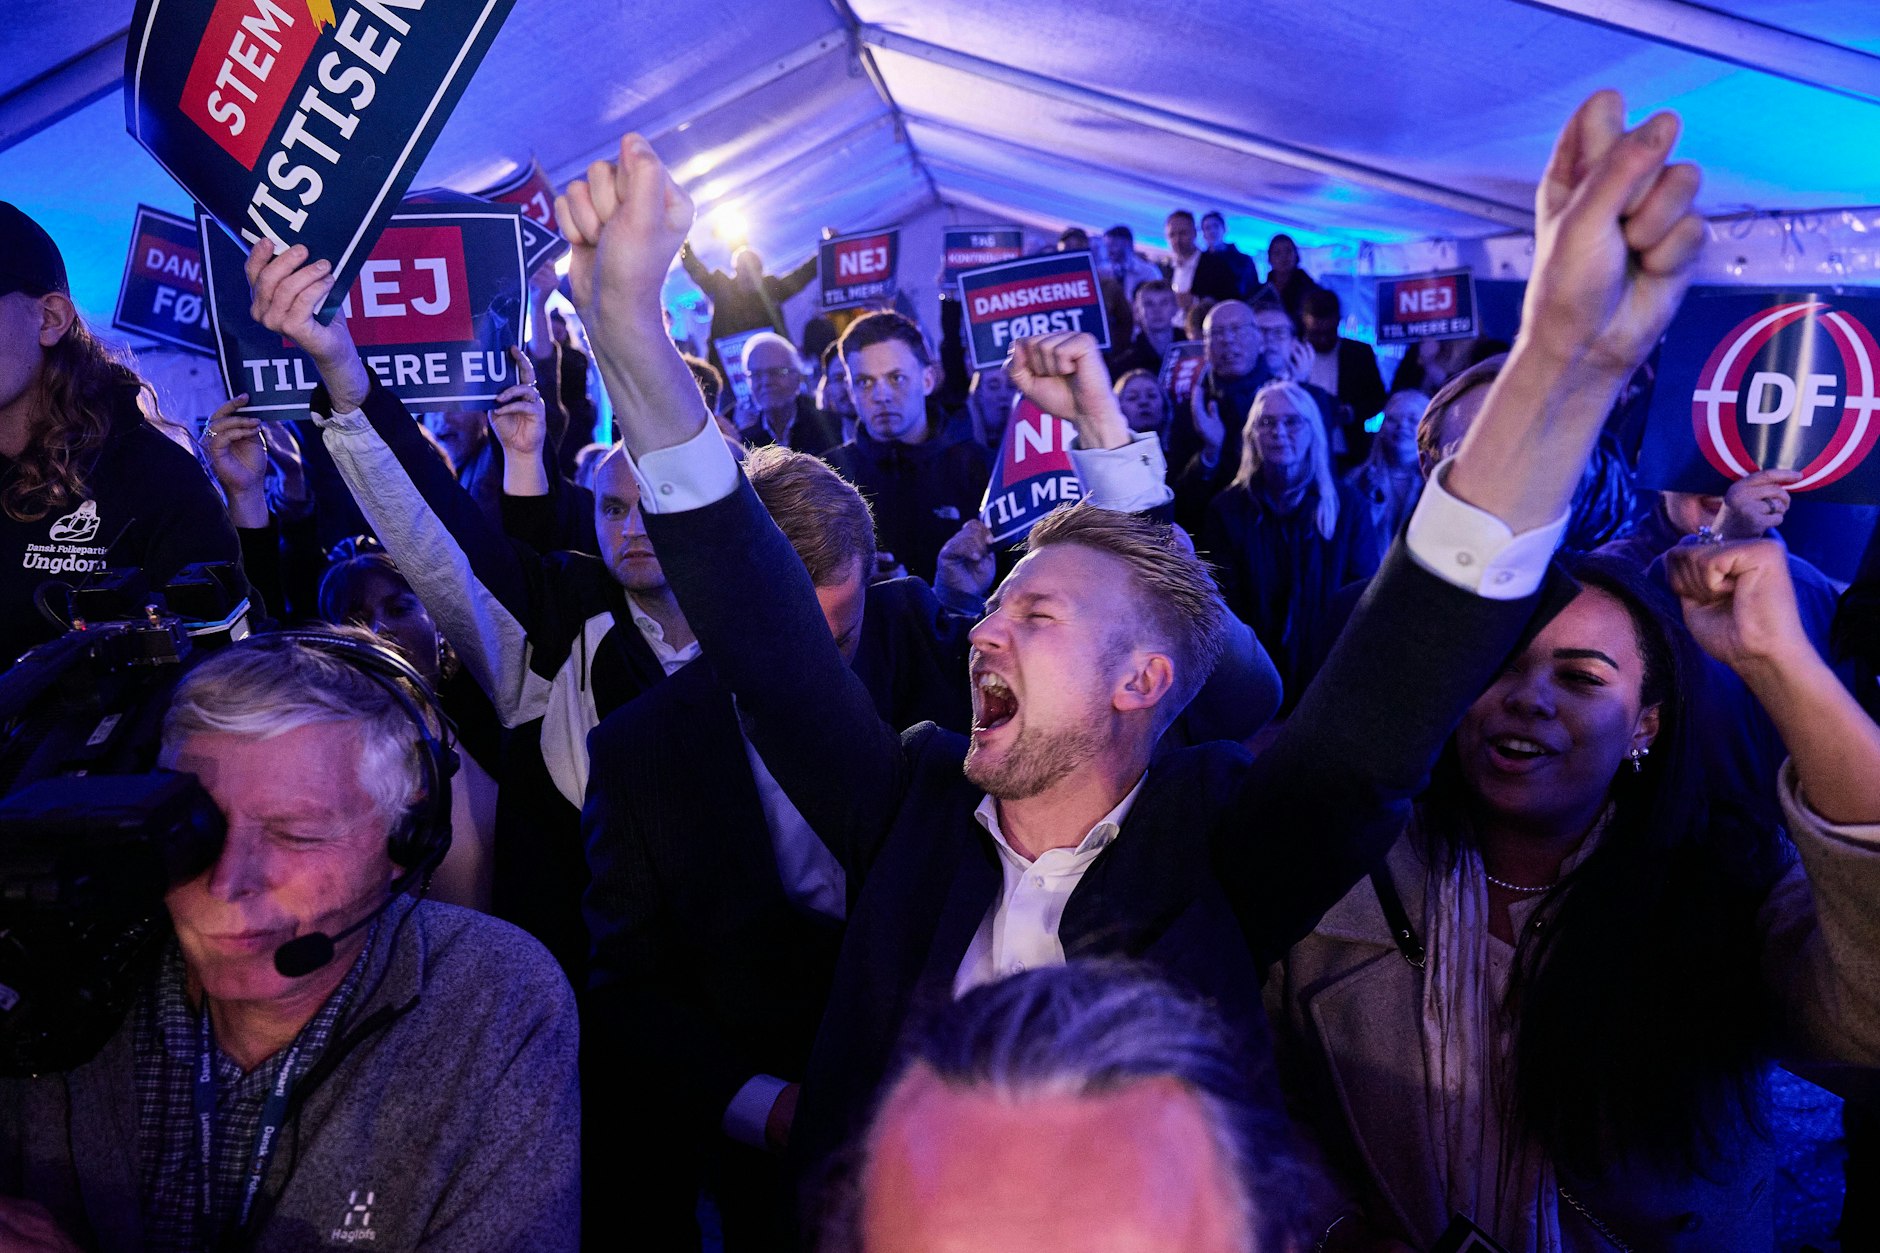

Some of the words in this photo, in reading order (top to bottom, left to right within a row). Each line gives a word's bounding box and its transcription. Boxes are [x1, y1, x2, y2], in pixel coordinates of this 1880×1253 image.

[207, 0, 295, 136] STEM
[146, 248, 203, 283] DAN
[840, 247, 887, 277] NEJ
[341, 257, 451, 319] EJ
[973, 280, 1091, 316] DANSKERNE
[1399, 286, 1452, 314] NEJ
[152, 285, 210, 330] FØ
[991, 309, 1083, 347] FØRST
[1383, 324, 1404, 338] TIL
[1406, 319, 1448, 336] MERE
[1450, 317, 1471, 332] EU
[243, 358, 318, 392] TIL
[362, 352, 450, 388] ERE
[461, 350, 507, 382] EU
[1746, 372, 1838, 427] DF
[983, 491, 1026, 529] TIL
[26, 543, 56, 553] Dansk
[275, 1047, 300, 1097] Folkeparti
[257, 1125, 275, 1157] Dansk
